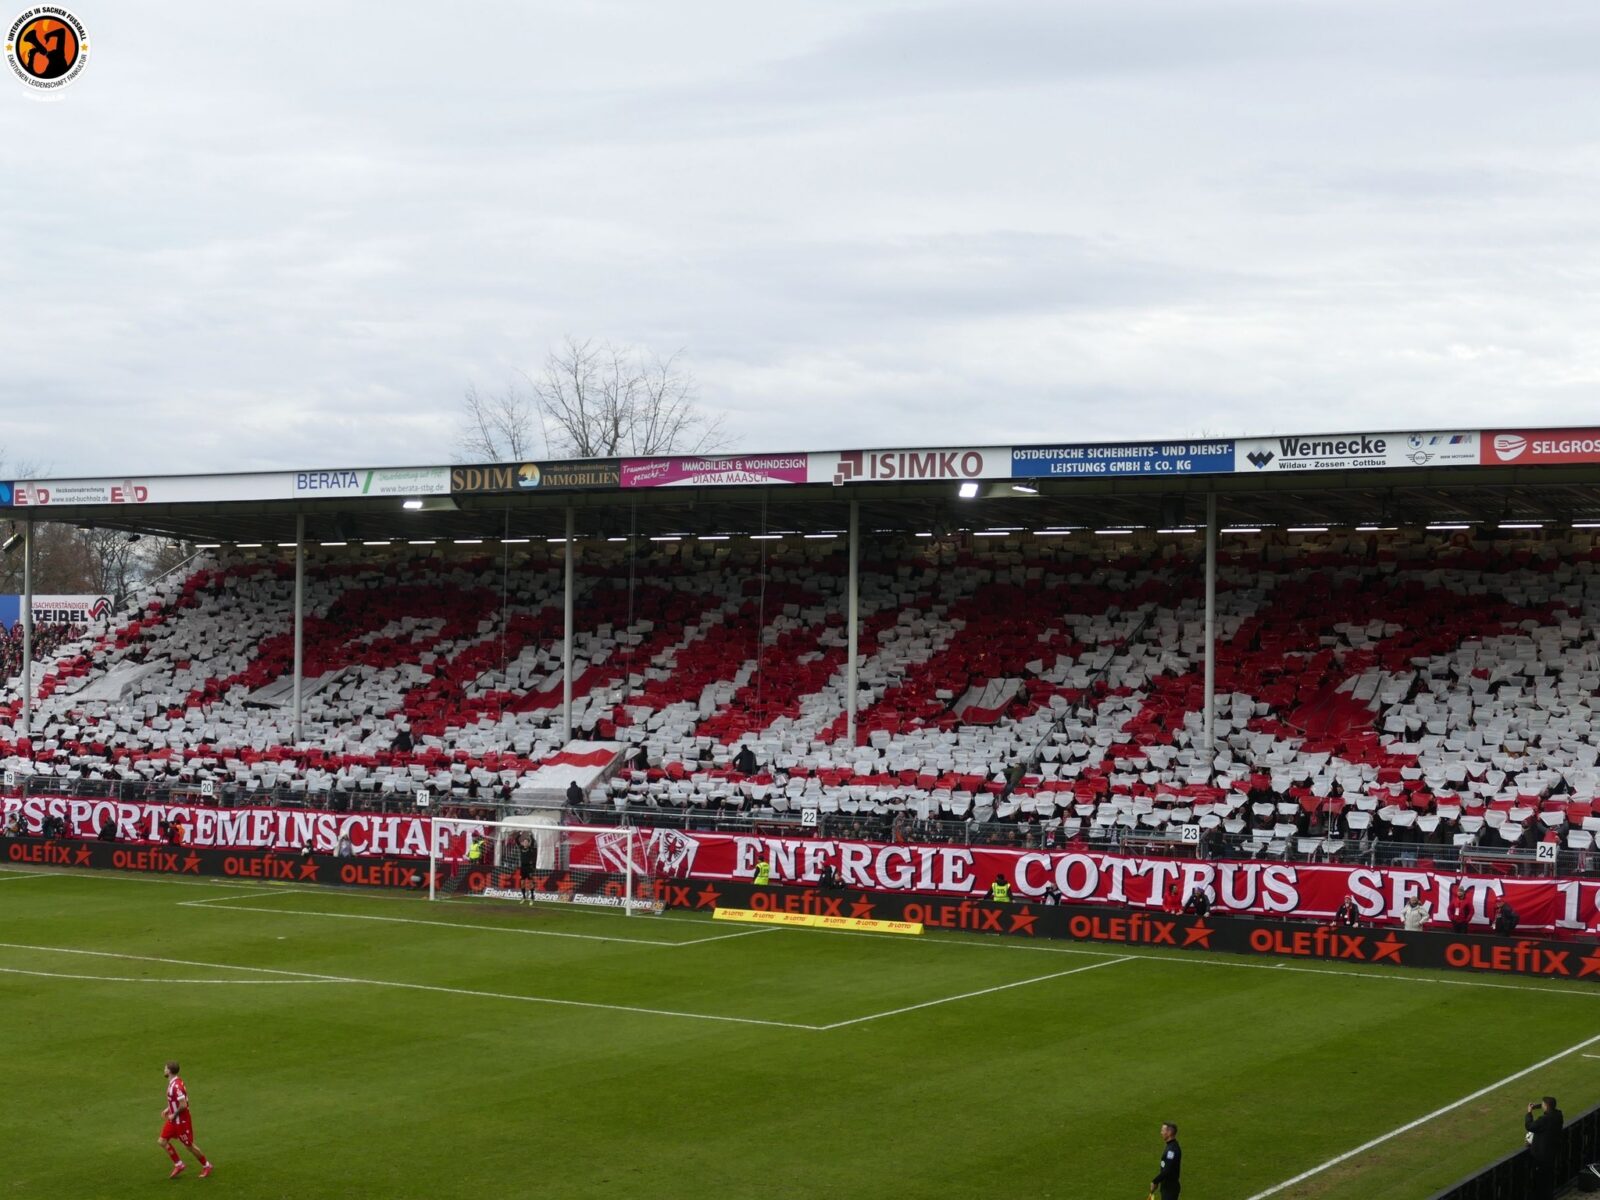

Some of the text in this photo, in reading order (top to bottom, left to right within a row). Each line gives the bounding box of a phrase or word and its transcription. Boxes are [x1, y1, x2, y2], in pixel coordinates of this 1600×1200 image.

[1013, 445, 1233, 460] OSTDEUTSCHE SICHERHEITS- UND DIENST-
[1279, 435, 1387, 457] Wernecke
[1532, 440, 1600, 454] SELGROS
[682, 458, 806, 472] IMMOBILIEN & WOHNDESIGN
[870, 451, 983, 479] ISIMKO
[1051, 460, 1191, 473] LEISTUNGS GMBH & CO. KG
[1279, 459, 1386, 469] Wildau Zossen Cottbus
[297, 472, 359, 490] BERATA
[452, 467, 514, 491] SDIM
[542, 472, 620, 486] IMMOBILIEN
[692, 471, 768, 484] DIANA MAASCH
[31, 609, 88, 622] TEIDEL
[6, 774, 12, 783] 19
[203, 783, 211, 792] 20
[419, 792, 427, 802] 21
[804, 812, 815, 823] 22
[1184, 828, 1197, 840] 23
[1539, 845, 1553, 858] 24
[733, 835, 975, 892] ENERGIE
[1014, 852, 1299, 912] COTTBUS
[1347, 868, 1503, 925] SEIT
[573, 894, 618, 906] Eisenbach
